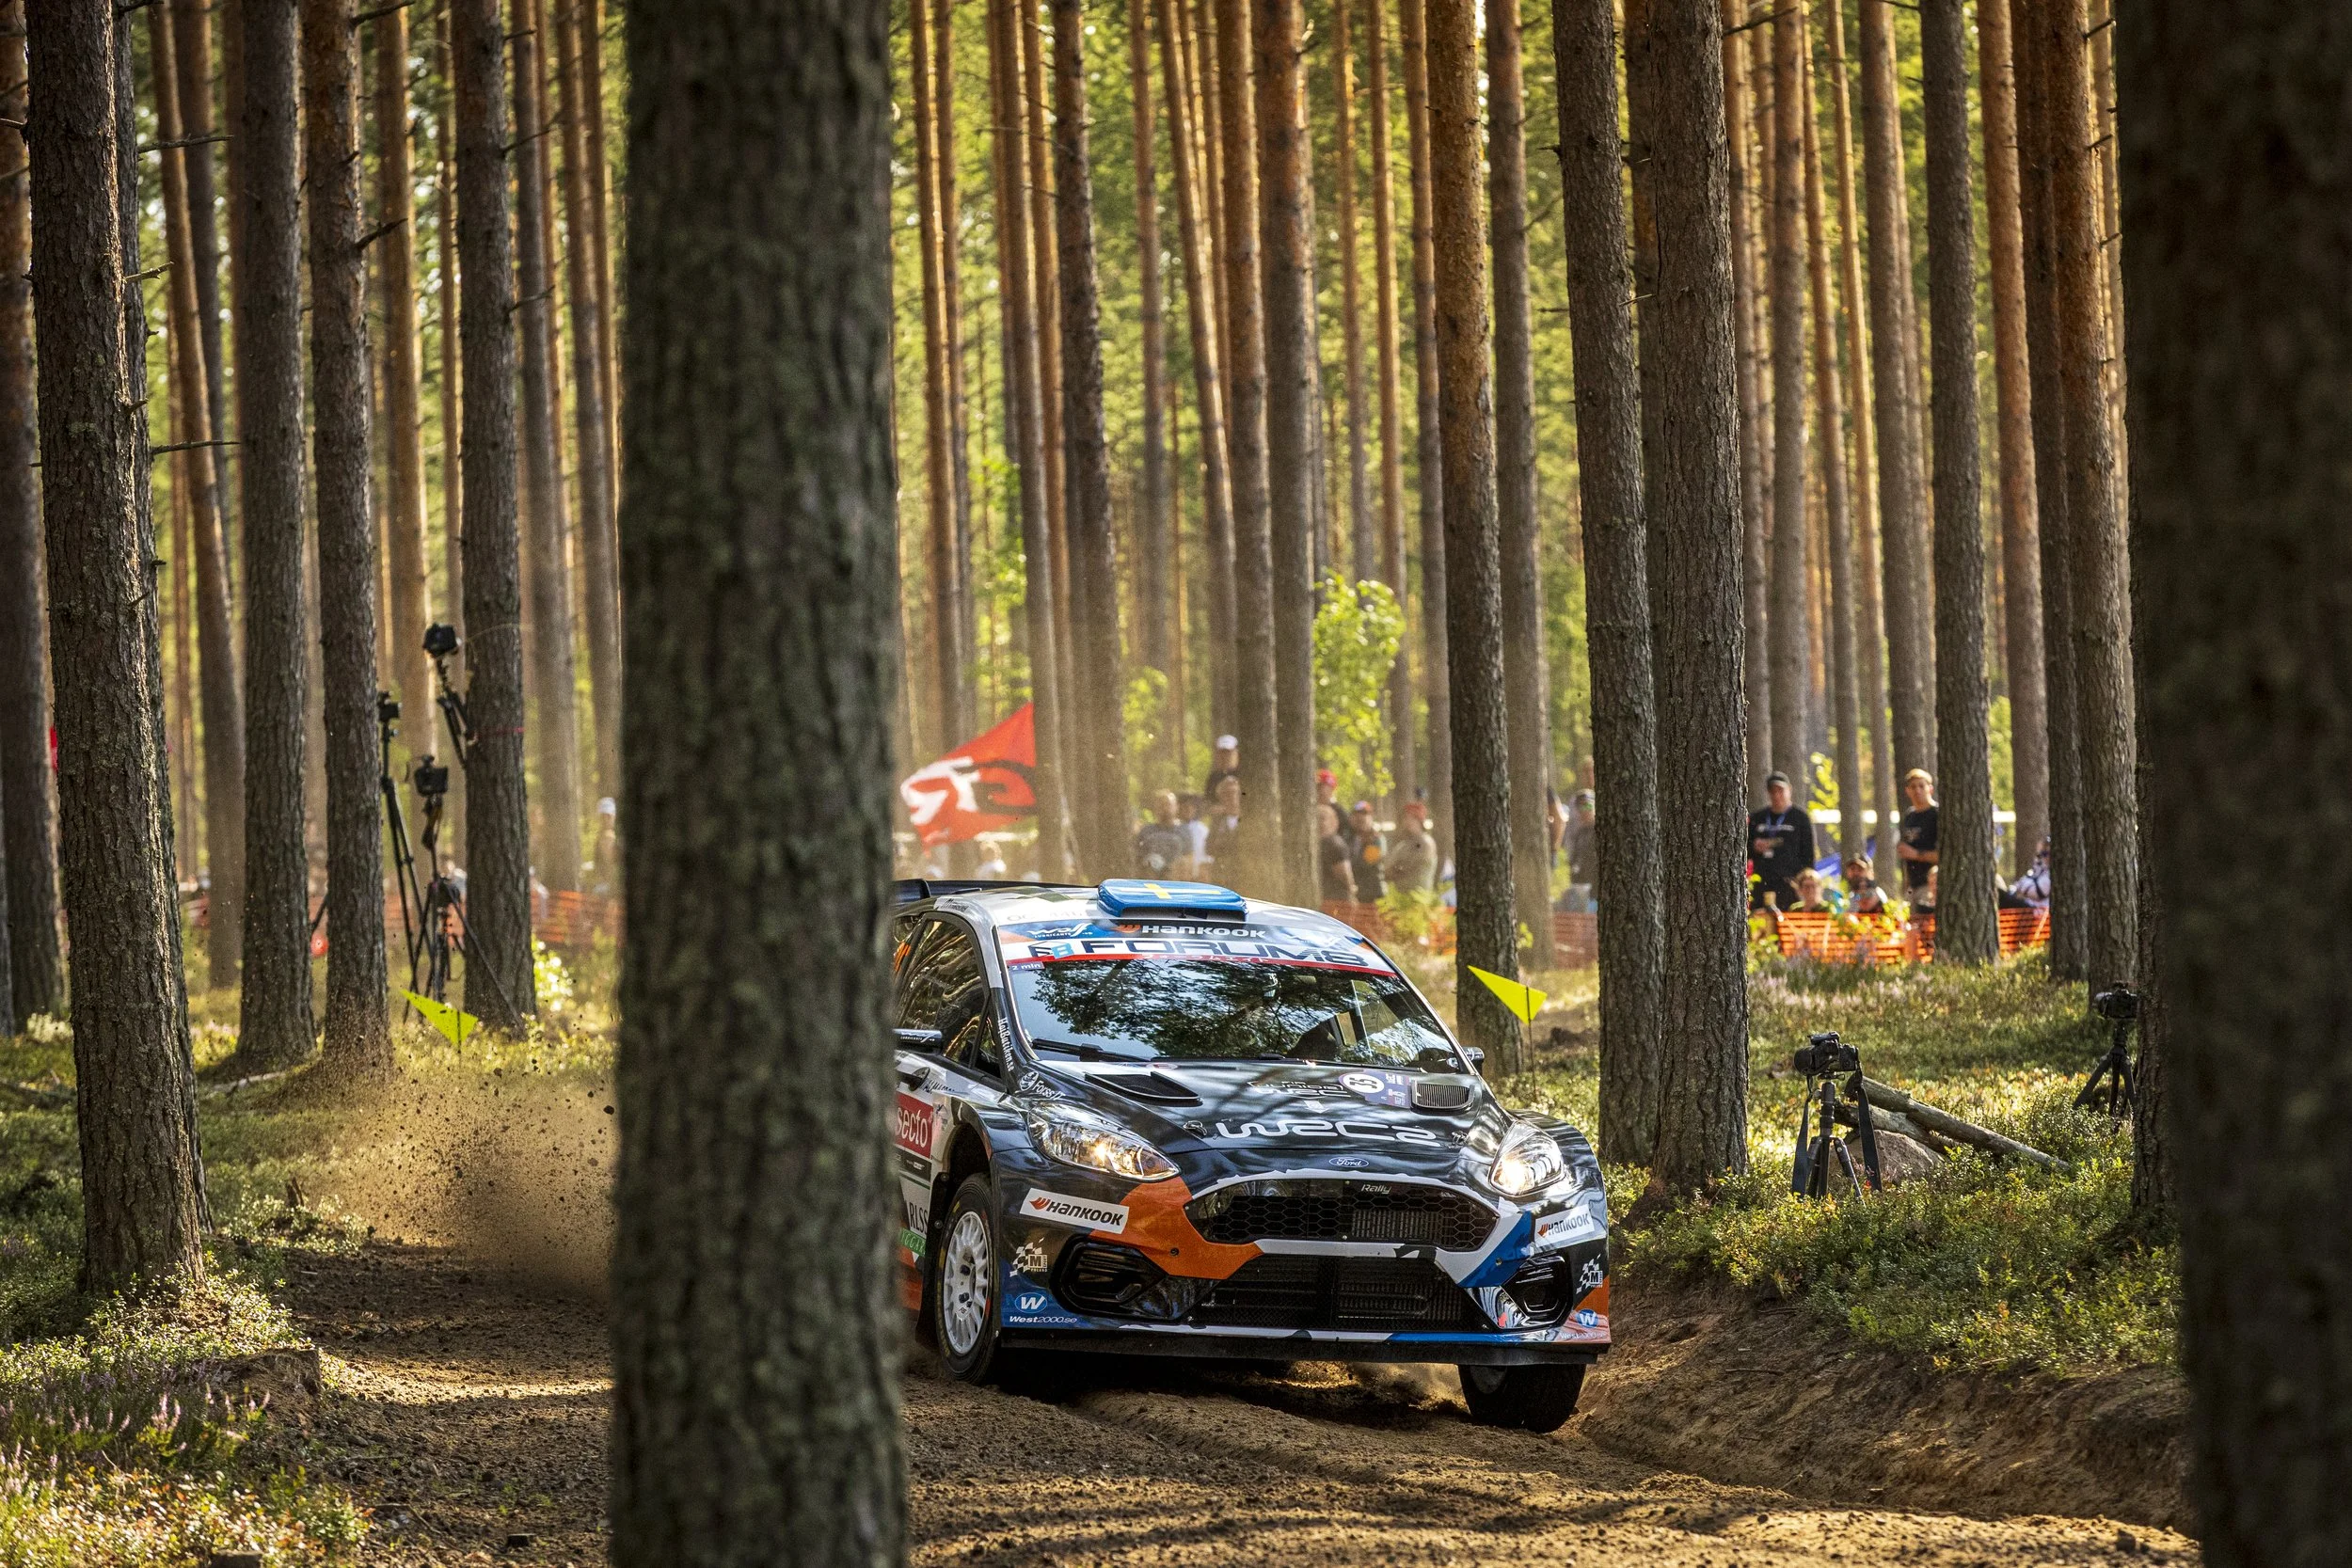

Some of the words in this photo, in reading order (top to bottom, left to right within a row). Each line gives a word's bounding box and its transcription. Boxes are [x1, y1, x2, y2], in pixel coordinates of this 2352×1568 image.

[1141, 925, 1266, 939] HANKOOK
[1081, 941, 1369, 967] FORUM8
[1020, 962, 1041, 971] min
[895, 1107, 929, 1148] secto
[1336, 1157, 1363, 1167] Ford
[1360, 1183, 1392, 1195] Rally
[1045, 1201, 1124, 1227] HANKOOK
[1548, 1212, 1590, 1237] HANKOOK
[1029, 1255, 1042, 1267] M
[1020, 1296, 1046, 1310] W
[1009, 1315, 1078, 1323] West2000.se
[1579, 1311, 1597, 1326] W
